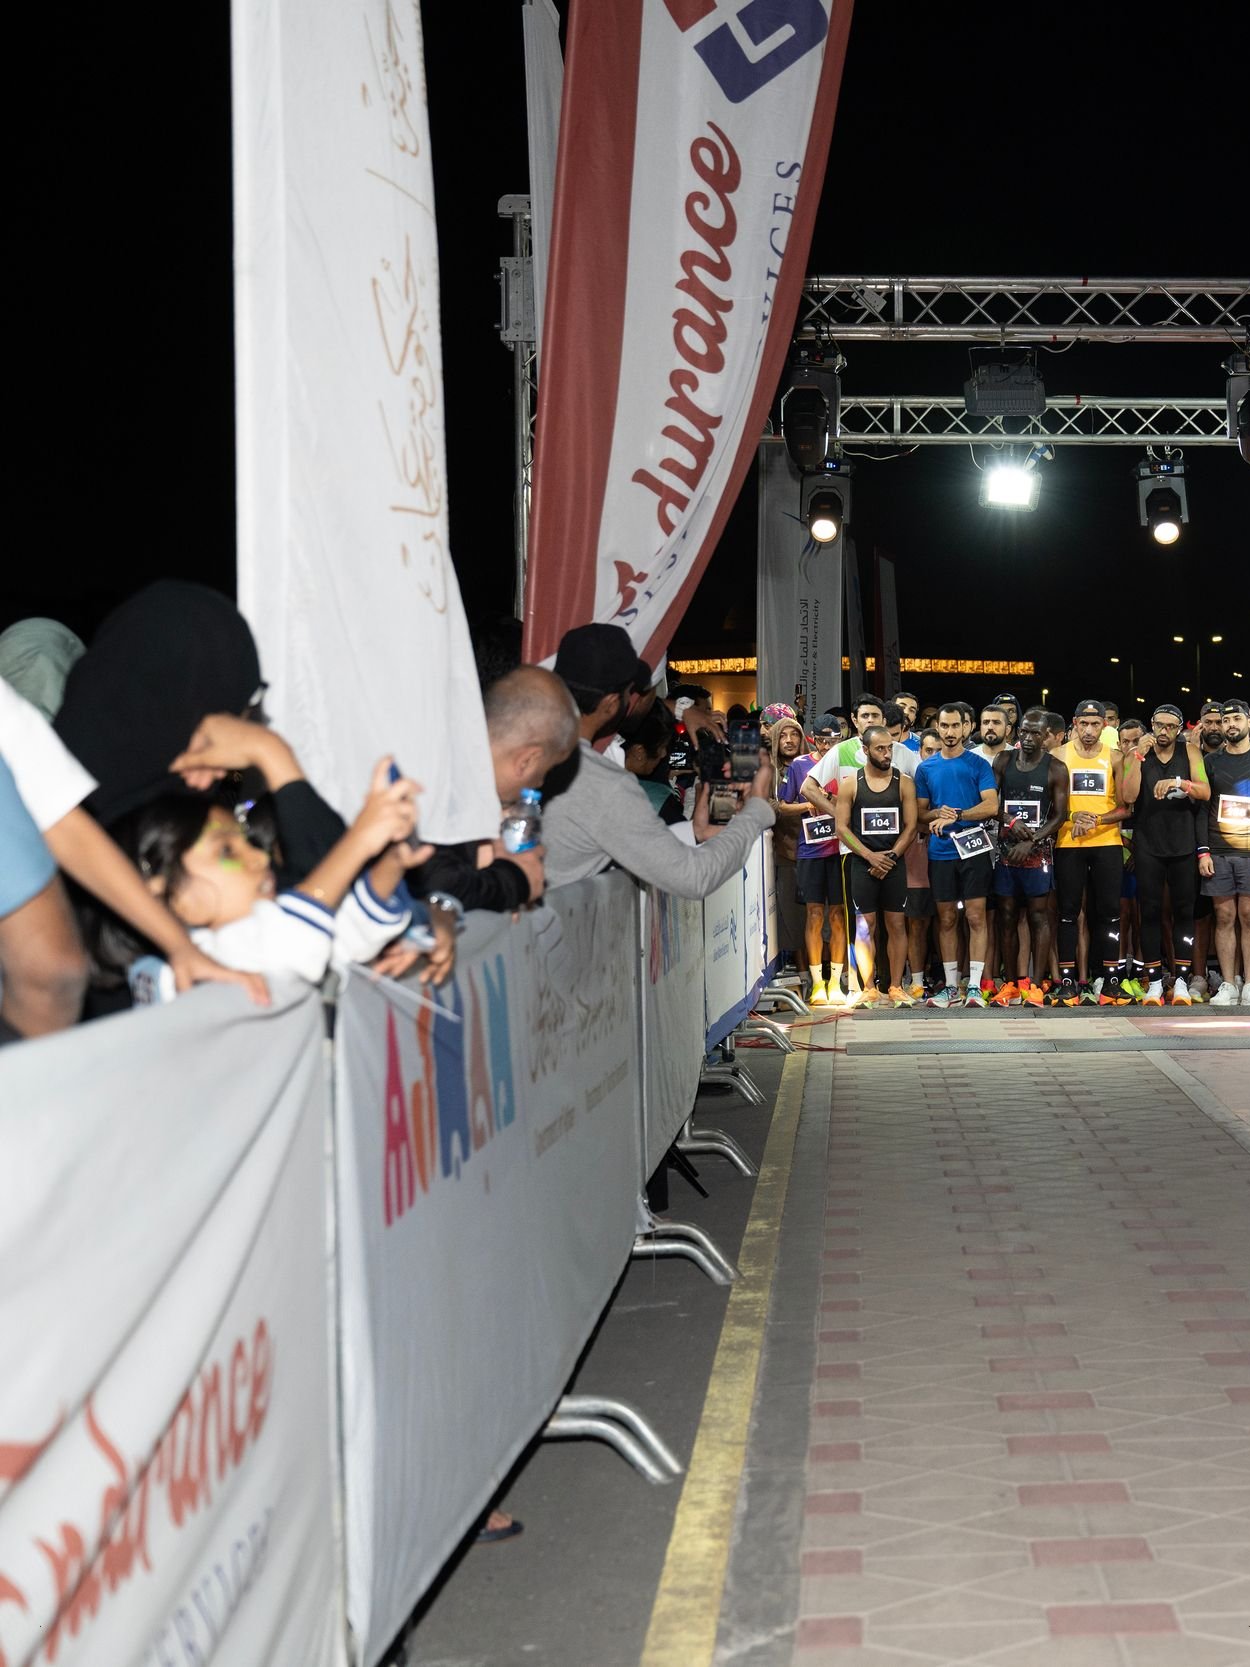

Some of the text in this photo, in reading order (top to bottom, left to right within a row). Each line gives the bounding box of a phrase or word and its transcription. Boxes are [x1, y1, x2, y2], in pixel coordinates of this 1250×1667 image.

[614, 121, 742, 621] durance
[1082, 779, 1095, 787] 15
[1016, 811, 1029, 819] 25
[871, 819, 889, 827] 104
[813, 825, 831, 835] 143
[965, 837, 982, 849] 130
